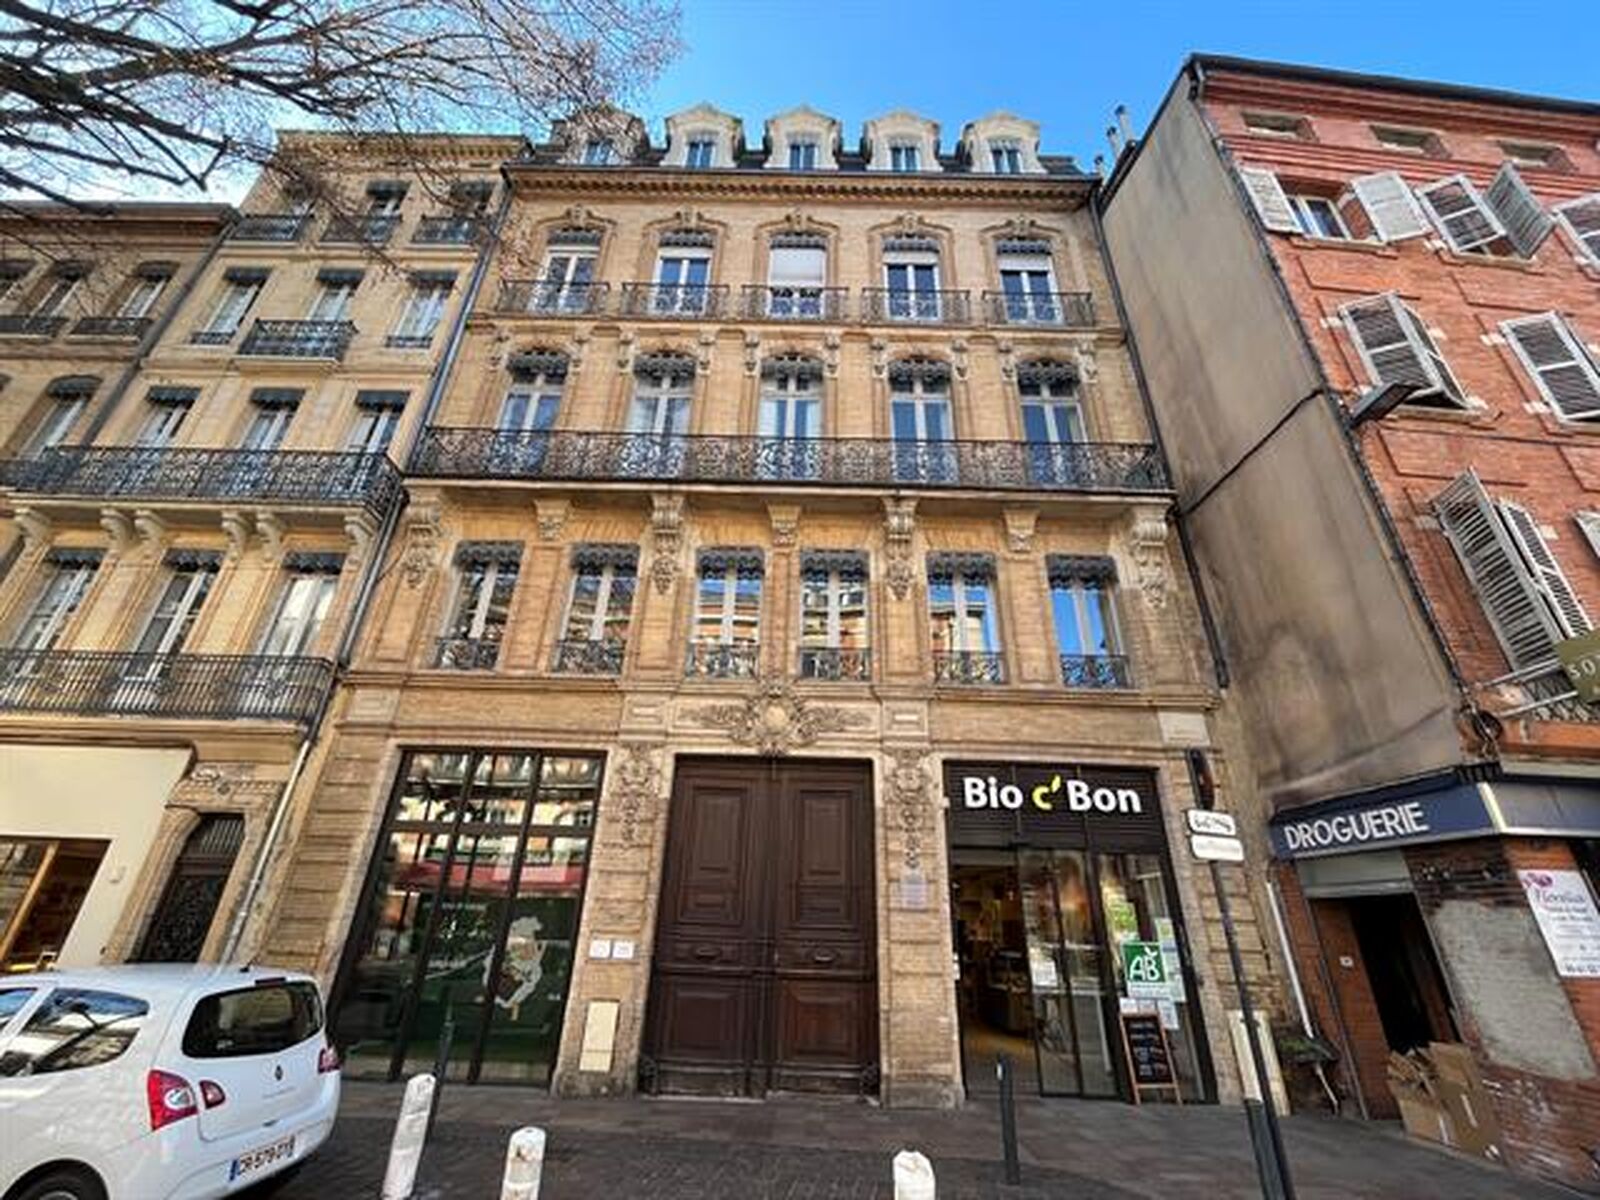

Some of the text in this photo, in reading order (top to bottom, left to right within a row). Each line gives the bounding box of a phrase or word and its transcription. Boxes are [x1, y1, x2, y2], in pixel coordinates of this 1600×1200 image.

[963, 776, 1023, 809] Bio
[1066, 779, 1142, 813] Bon
[1284, 802, 1430, 849] DROGUERIE
[1130, 955, 1160, 981] AB
